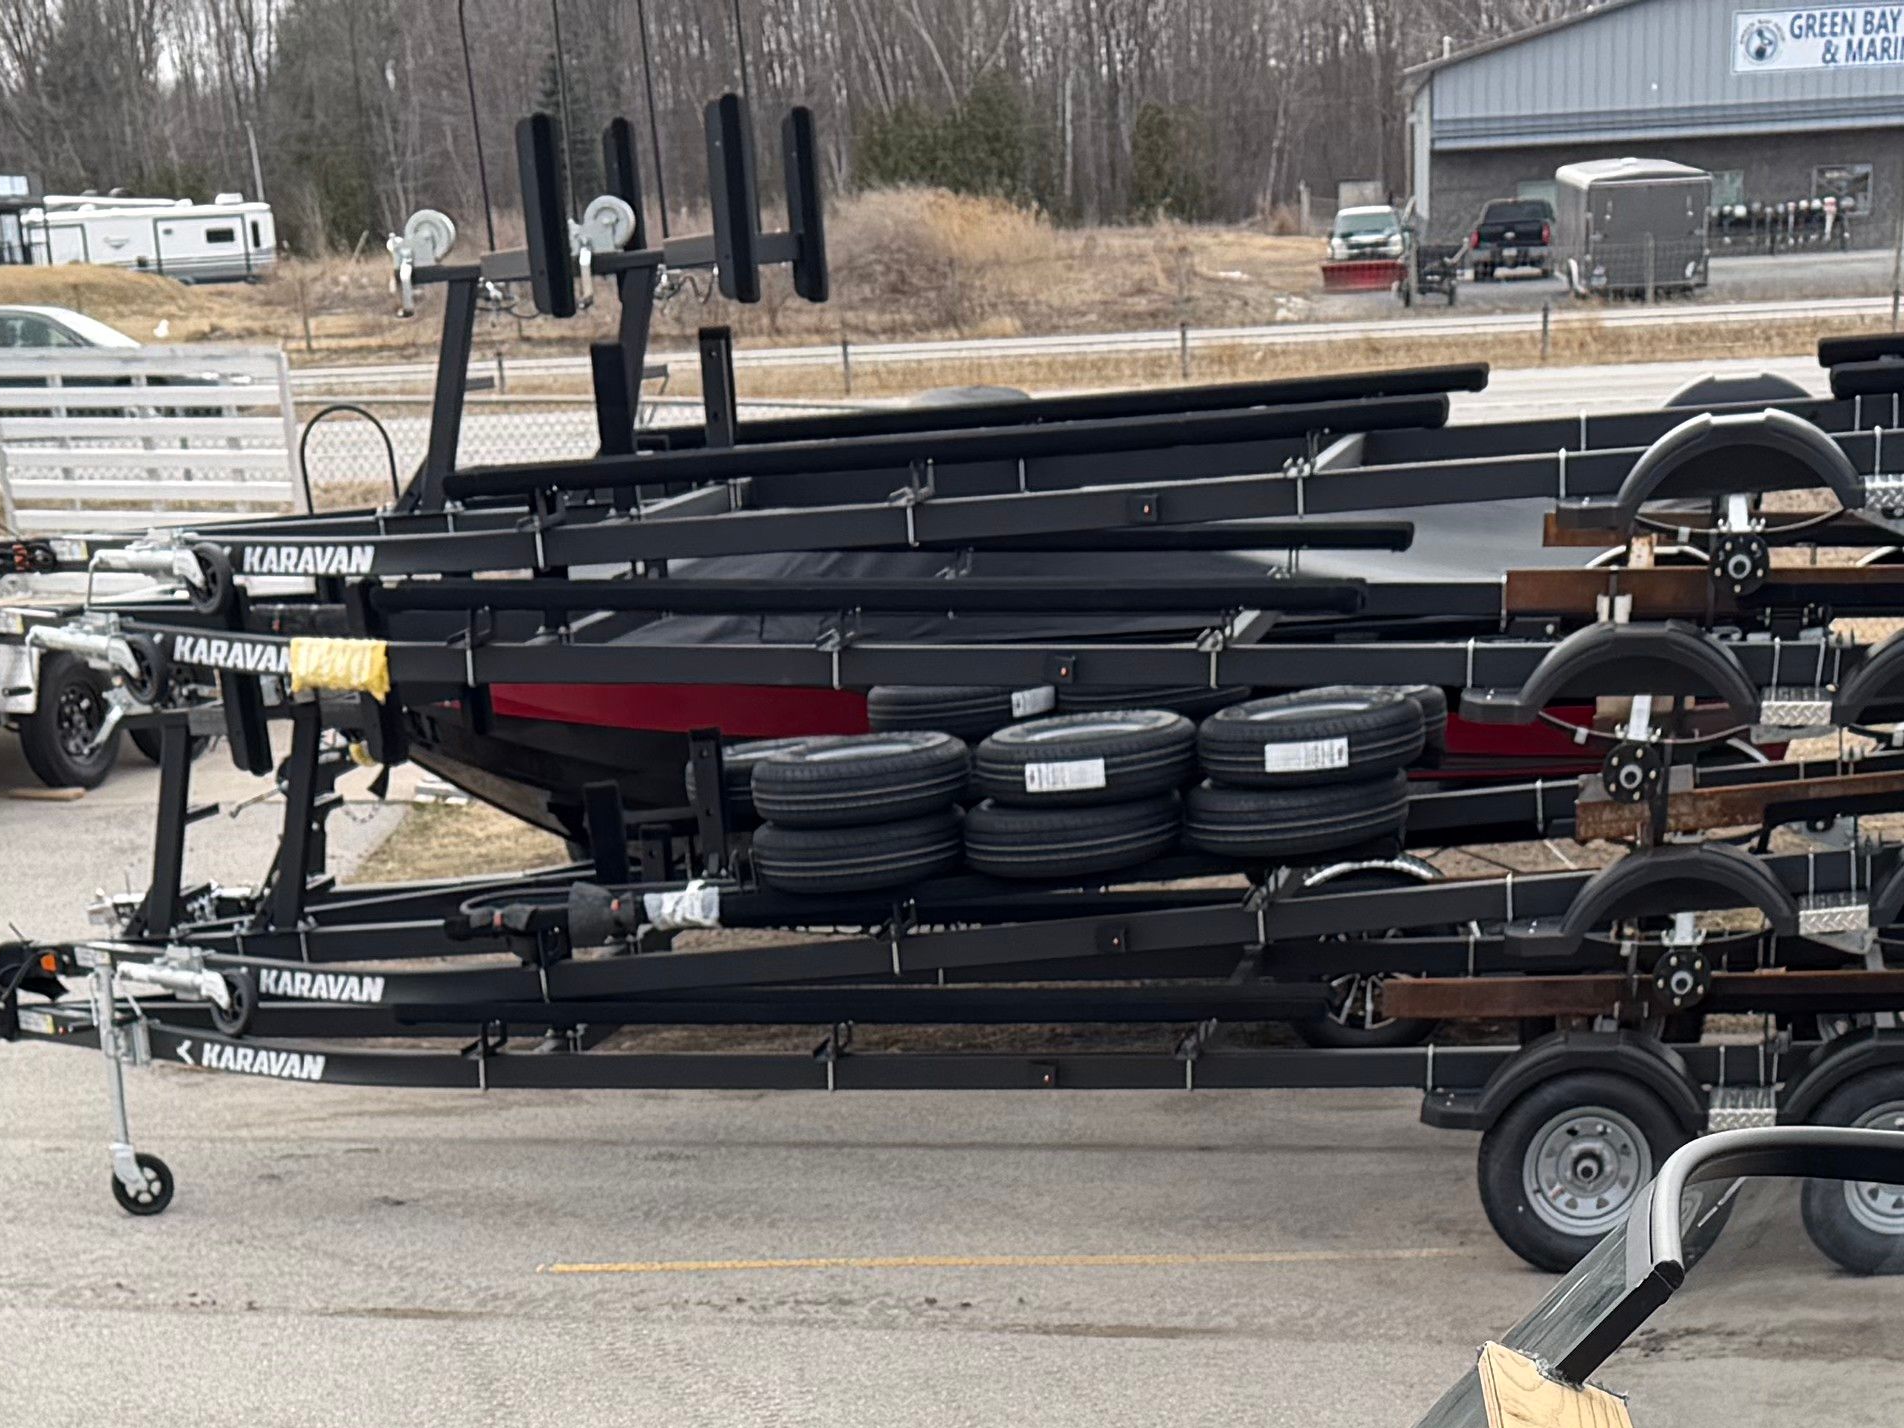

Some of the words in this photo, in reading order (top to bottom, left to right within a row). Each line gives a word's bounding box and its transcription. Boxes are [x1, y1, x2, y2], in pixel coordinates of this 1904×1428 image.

[1789, 11, 1856, 40] GREEN
[1862, 8, 1903, 36] BAY
[1821, 39, 1839, 65] &
[243, 545, 375, 574] KARAVAN
[258, 968, 385, 1003] KARAVAN
[201, 1042, 326, 1080] KARAVAN
